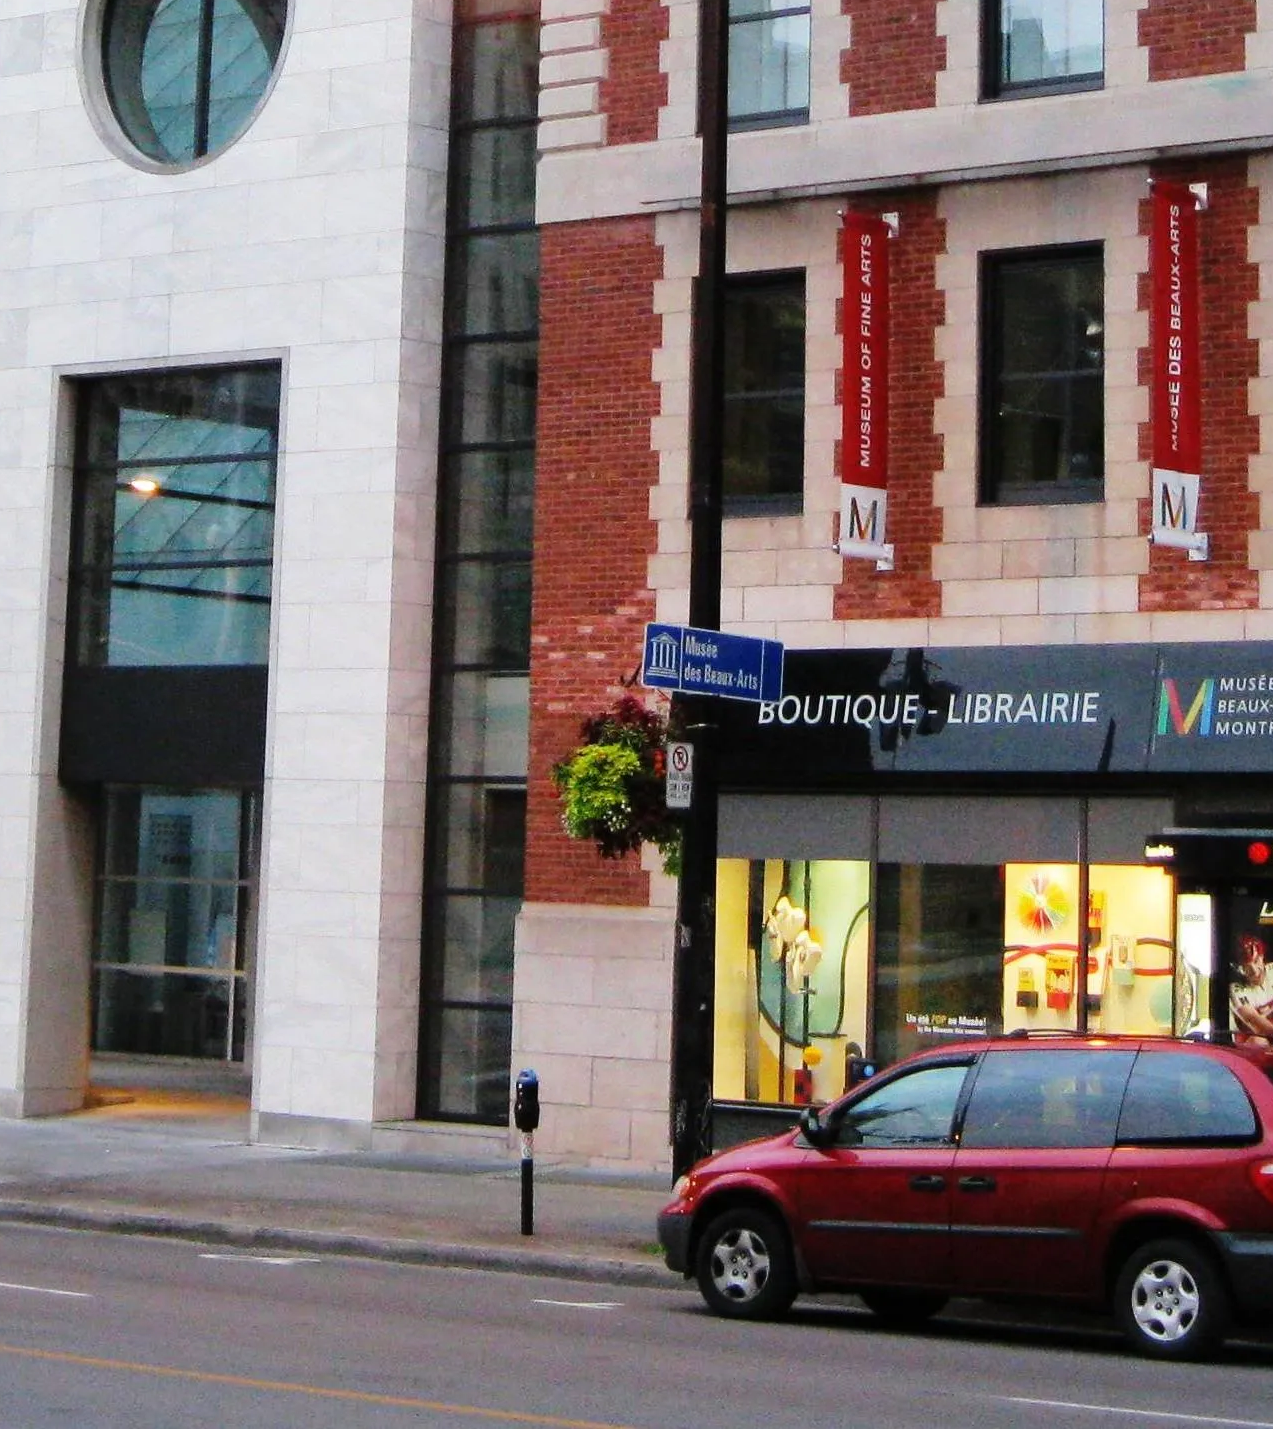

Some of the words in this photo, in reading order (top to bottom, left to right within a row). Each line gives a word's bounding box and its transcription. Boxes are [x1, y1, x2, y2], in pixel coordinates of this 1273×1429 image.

[860, 234, 872, 286] ARTS
[1170, 204, 1181, 330] BEAUX-ARTS
[860, 291, 872, 337] FINE
[860, 342, 872, 370] OF
[1168, 336, 1181, 376] DES
[860, 376, 872, 467] MUSEUM
[685, 635, 718, 658] Musée
[684, 662, 701, 683] des
[704, 665, 758, 691] Beaux-Arts
[758, 694, 920, 728] BOUTIQUE
[947, 692, 1101, 724] LIBRAIRIE
